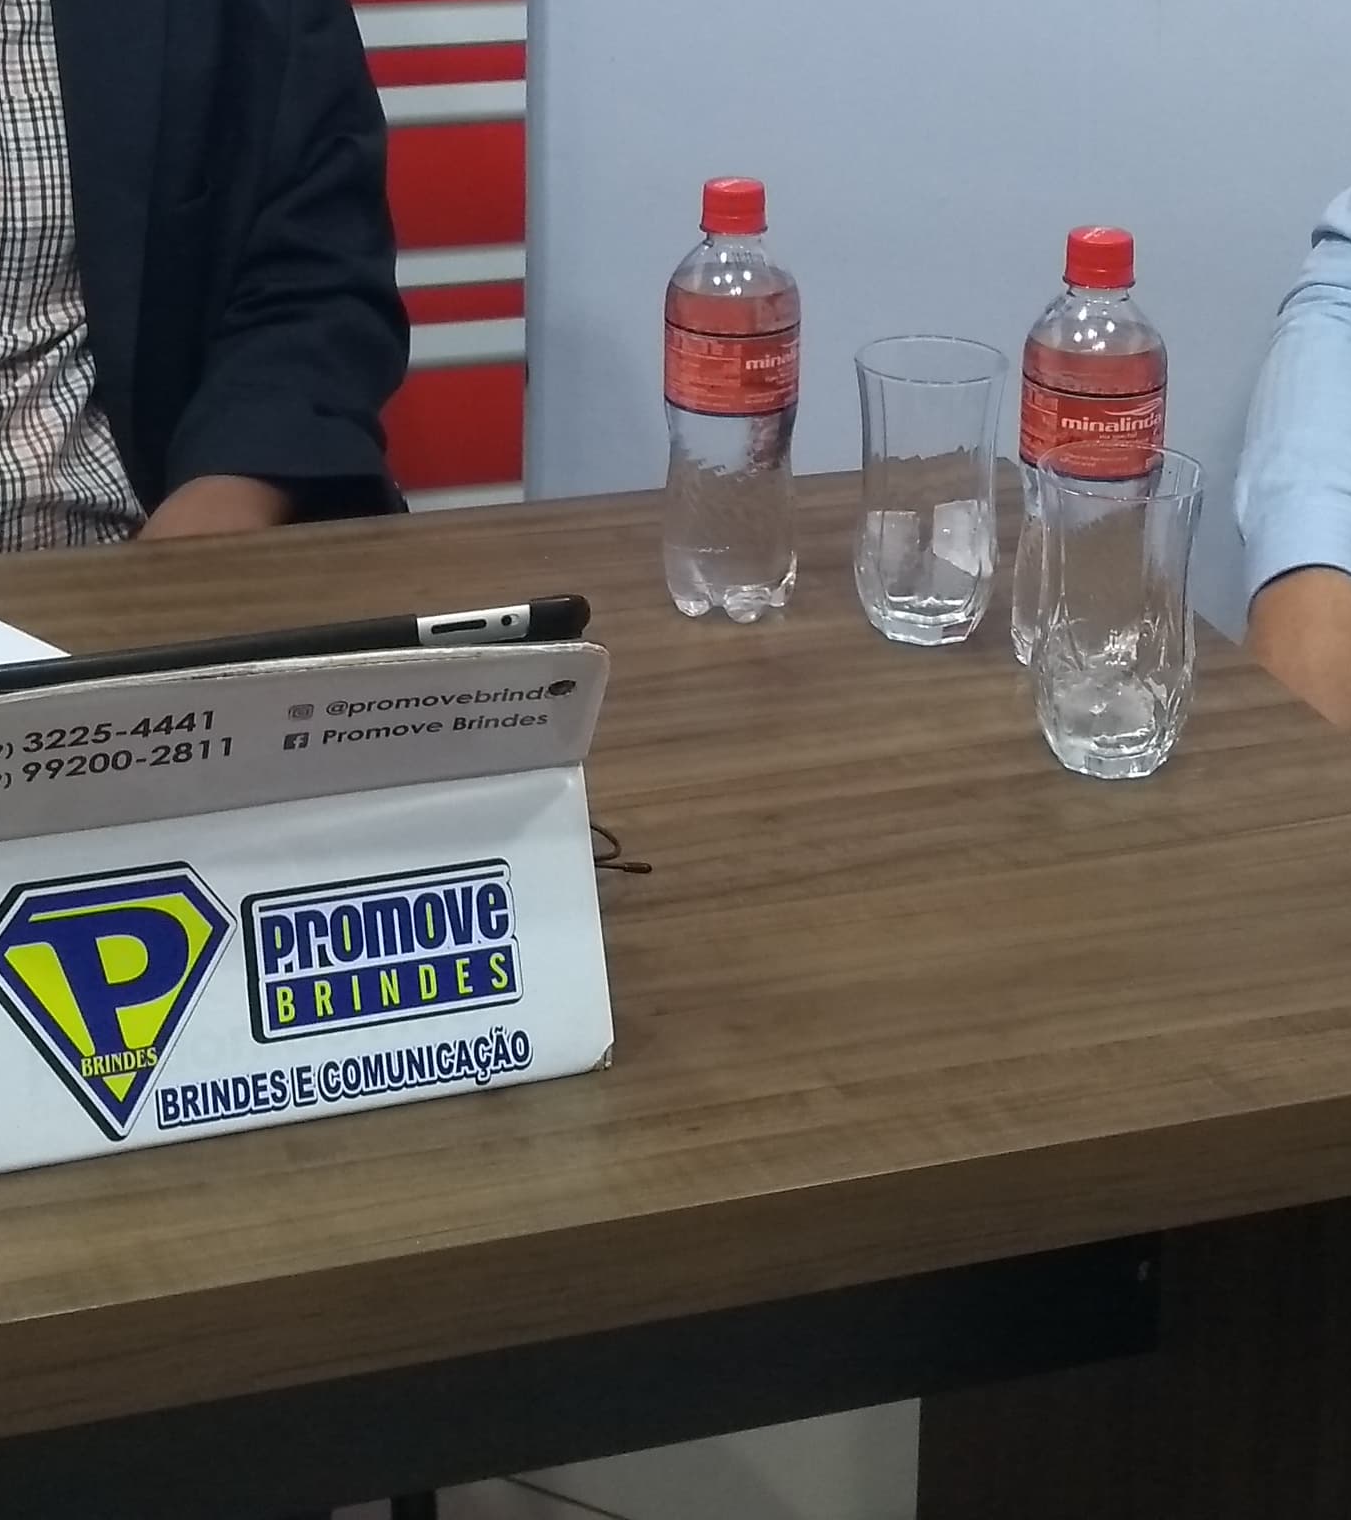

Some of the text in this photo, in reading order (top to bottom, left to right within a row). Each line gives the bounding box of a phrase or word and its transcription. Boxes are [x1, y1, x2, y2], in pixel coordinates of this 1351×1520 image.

[1061, 411, 1162, 433] minalinda
[22, 710, 214, 754] 3225-4441
[322, 712, 548, 745] Promove Brindes
[22, 736, 233, 783] 99200-2811
[276, 952, 509, 1024] BRINDES
[81, 1046, 159, 1078] BRINDES
[159, 1027, 531, 1123] BRINDES E COMUNICAÇÃO
